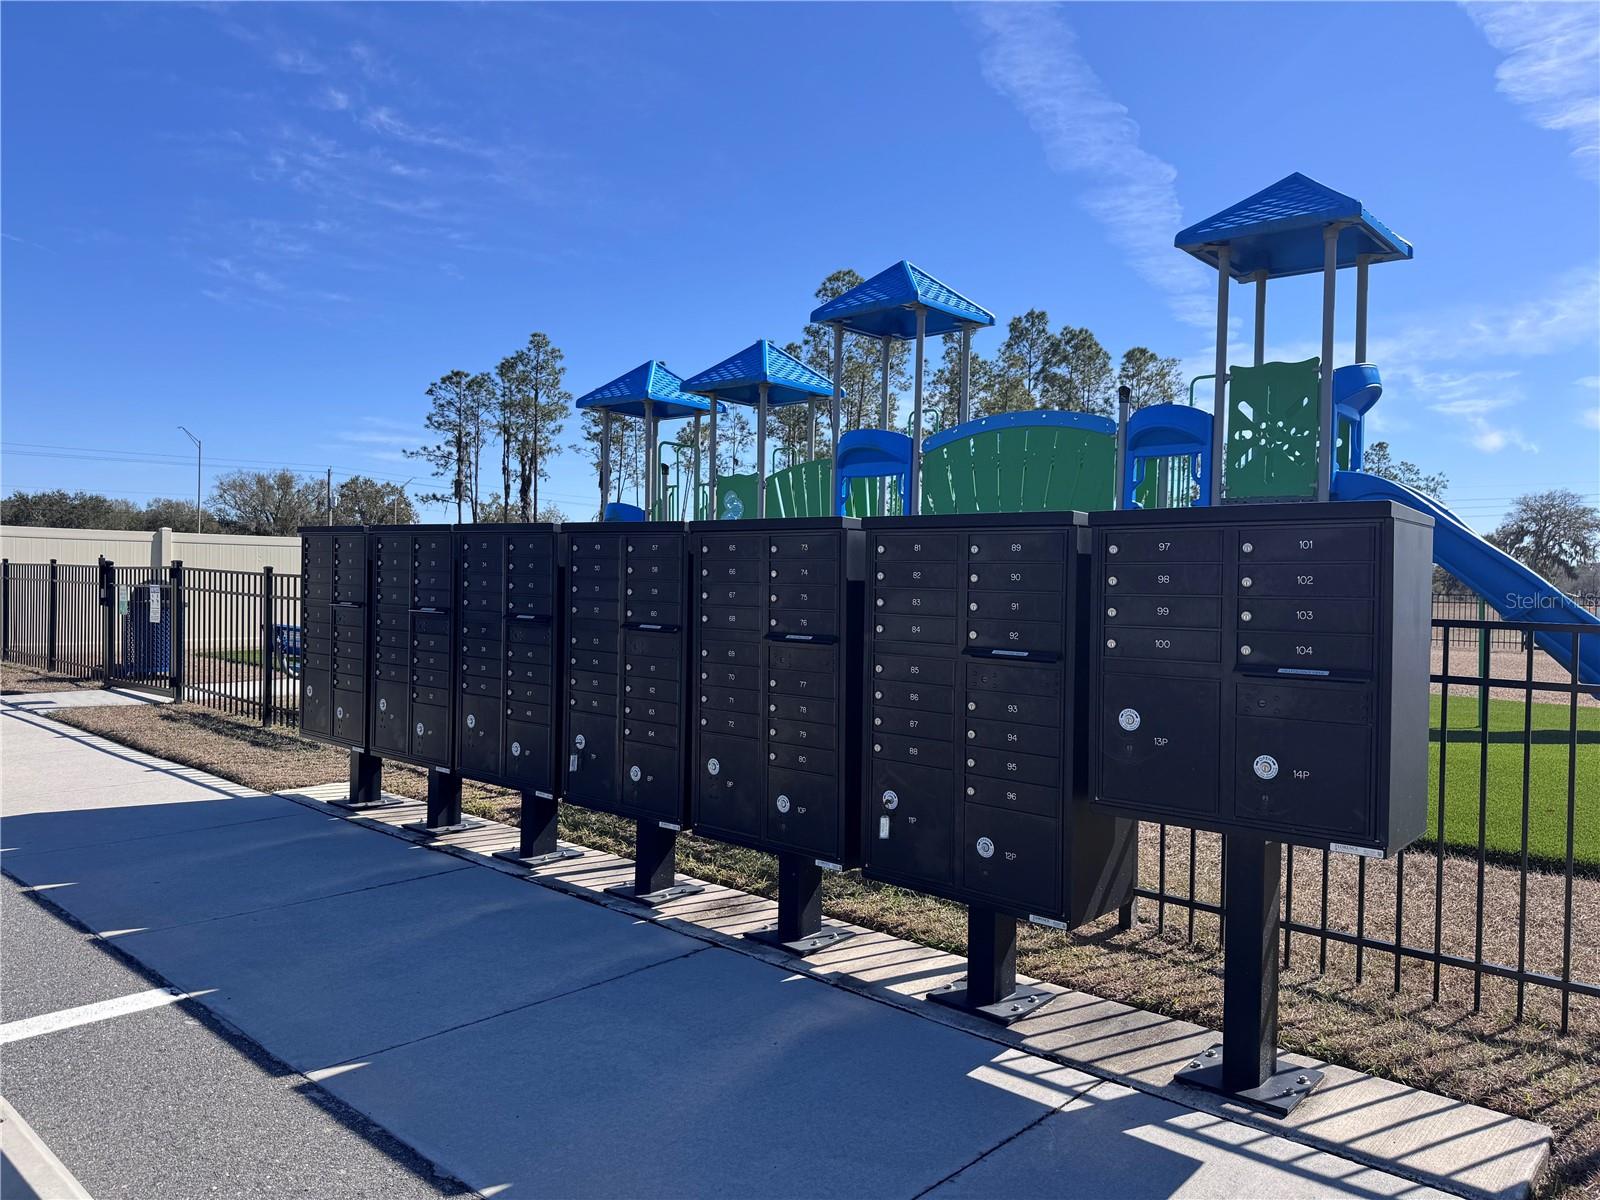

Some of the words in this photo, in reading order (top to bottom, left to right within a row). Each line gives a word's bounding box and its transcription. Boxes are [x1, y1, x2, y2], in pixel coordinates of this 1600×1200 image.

[728, 544, 736, 552] 65
[800, 543, 809, 551] 73
[913, 544, 921, 552] 81
[1011, 543, 1022, 552] 89
[1158, 542, 1171, 552] 97
[1299, 540, 1313, 550] 101
[800, 568, 809, 576] 74
[912, 571, 922, 579] 82
[1010, 573, 1021, 581] 90
[1157, 574, 1170, 584] 98
[1297, 575, 1314, 585] 102
[728, 591, 736, 599] 67
[911, 598, 921, 607] 83
[1010, 602, 1019, 611] 91
[1156, 606, 1170, 616] 99
[1296, 610, 1314, 620] 103
[799, 618, 808, 627] 76
[911, 625, 921, 634] 84
[1009, 631, 1019, 641] 92
[1155, 639, 1171, 649] 100
[1295, 645, 1313, 655] 104
[910, 665, 920, 674] 85
[727, 673, 736, 681] 70
[799, 680, 807, 688] 77
[909, 693, 919, 701] 86
[799, 705, 807, 714] 78
[1007, 704, 1018, 713] 93
[727, 720, 735, 728] 72
[909, 719, 919, 728] 87
[799, 730, 807, 738] 79
[1007, 733, 1018, 742] 94
[1154, 737, 1169, 746] 13P
[909, 747, 918, 756] 88
[798, 755, 807, 764] 80
[1006, 762, 1017, 771] 95
[1293, 769, 1310, 780] 14P
[1006, 791, 1017, 801] 96
[797, 806, 807, 814] 10P
[908, 816, 917, 824] 11P
[1004, 851, 1017, 861] 12P
